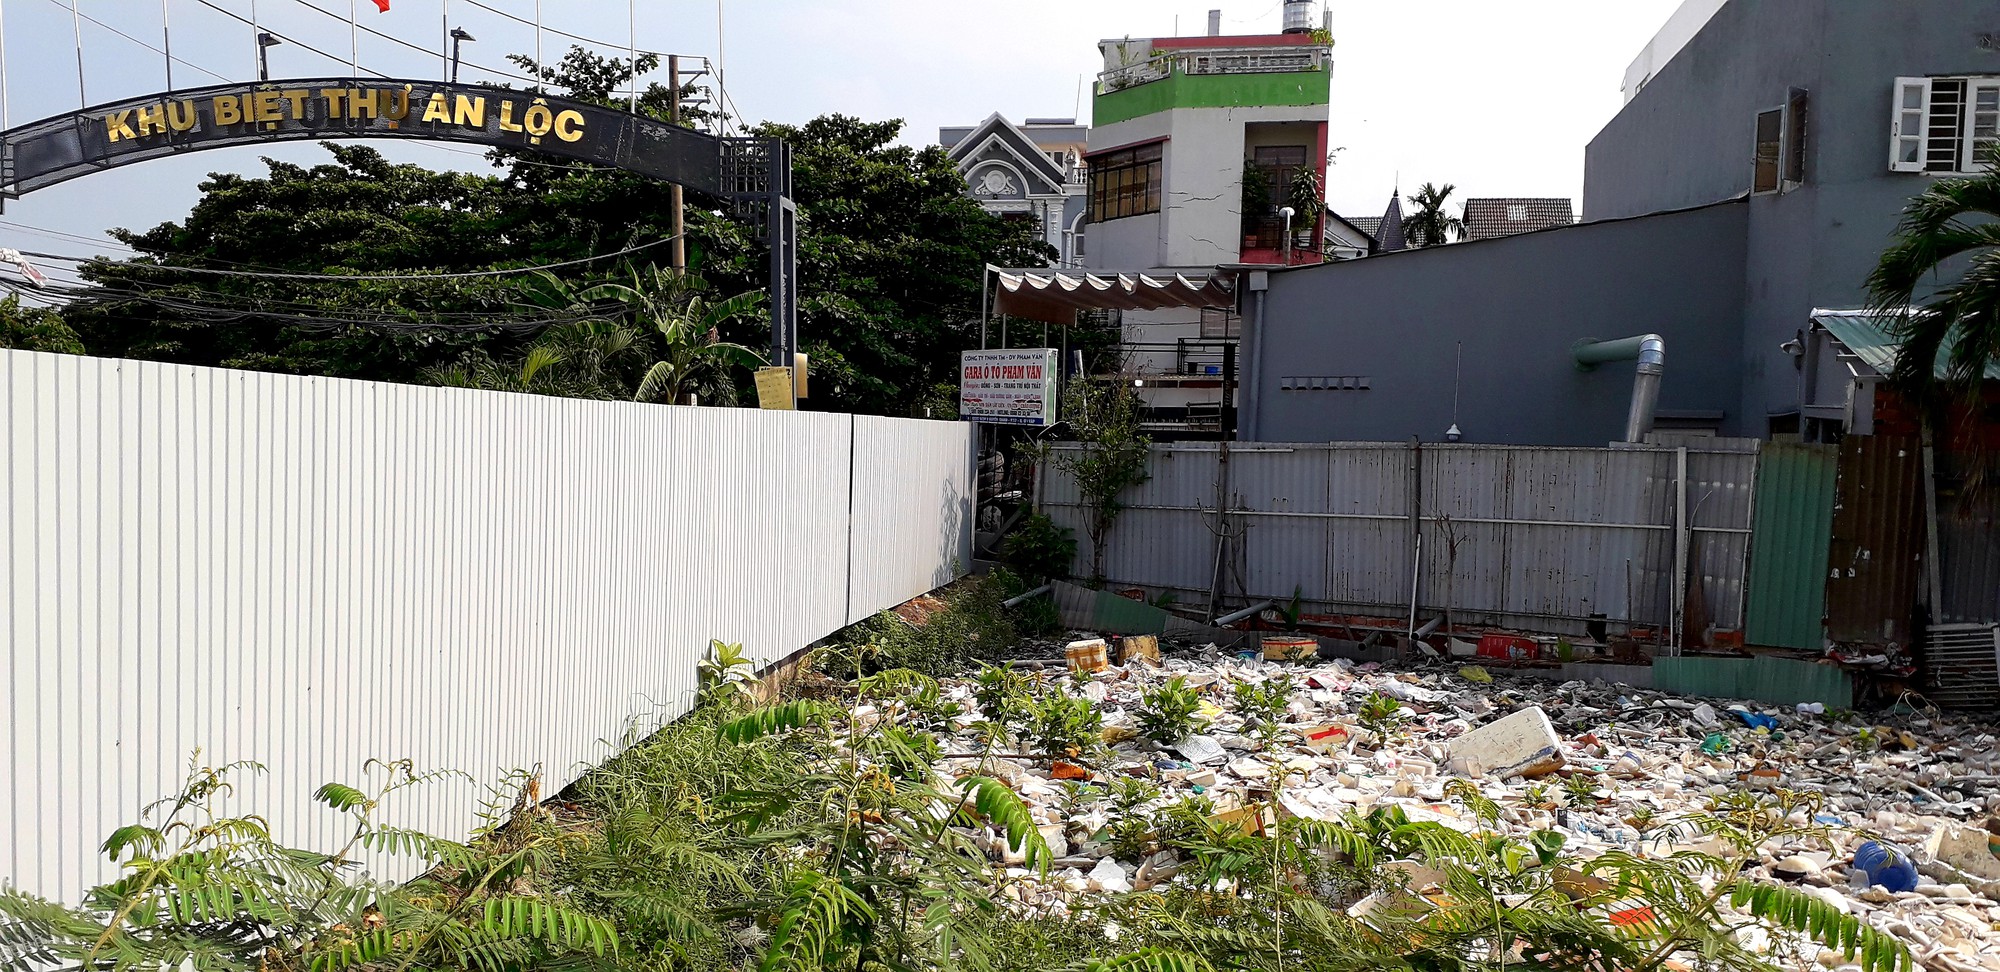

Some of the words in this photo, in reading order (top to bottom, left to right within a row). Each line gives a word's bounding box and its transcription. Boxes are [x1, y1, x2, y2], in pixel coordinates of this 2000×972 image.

[105, 99, 197, 143] KHU
[213, 84, 309, 131] BIỆT
[320, 83, 413, 130] THỰ
[422, 92, 485, 128] AN
[500, 98, 585, 146] LỘC
[964, 366, 982, 379] GARA
[984, 363, 989, 379] Ô
[991, 363, 1000, 379] TÔ
